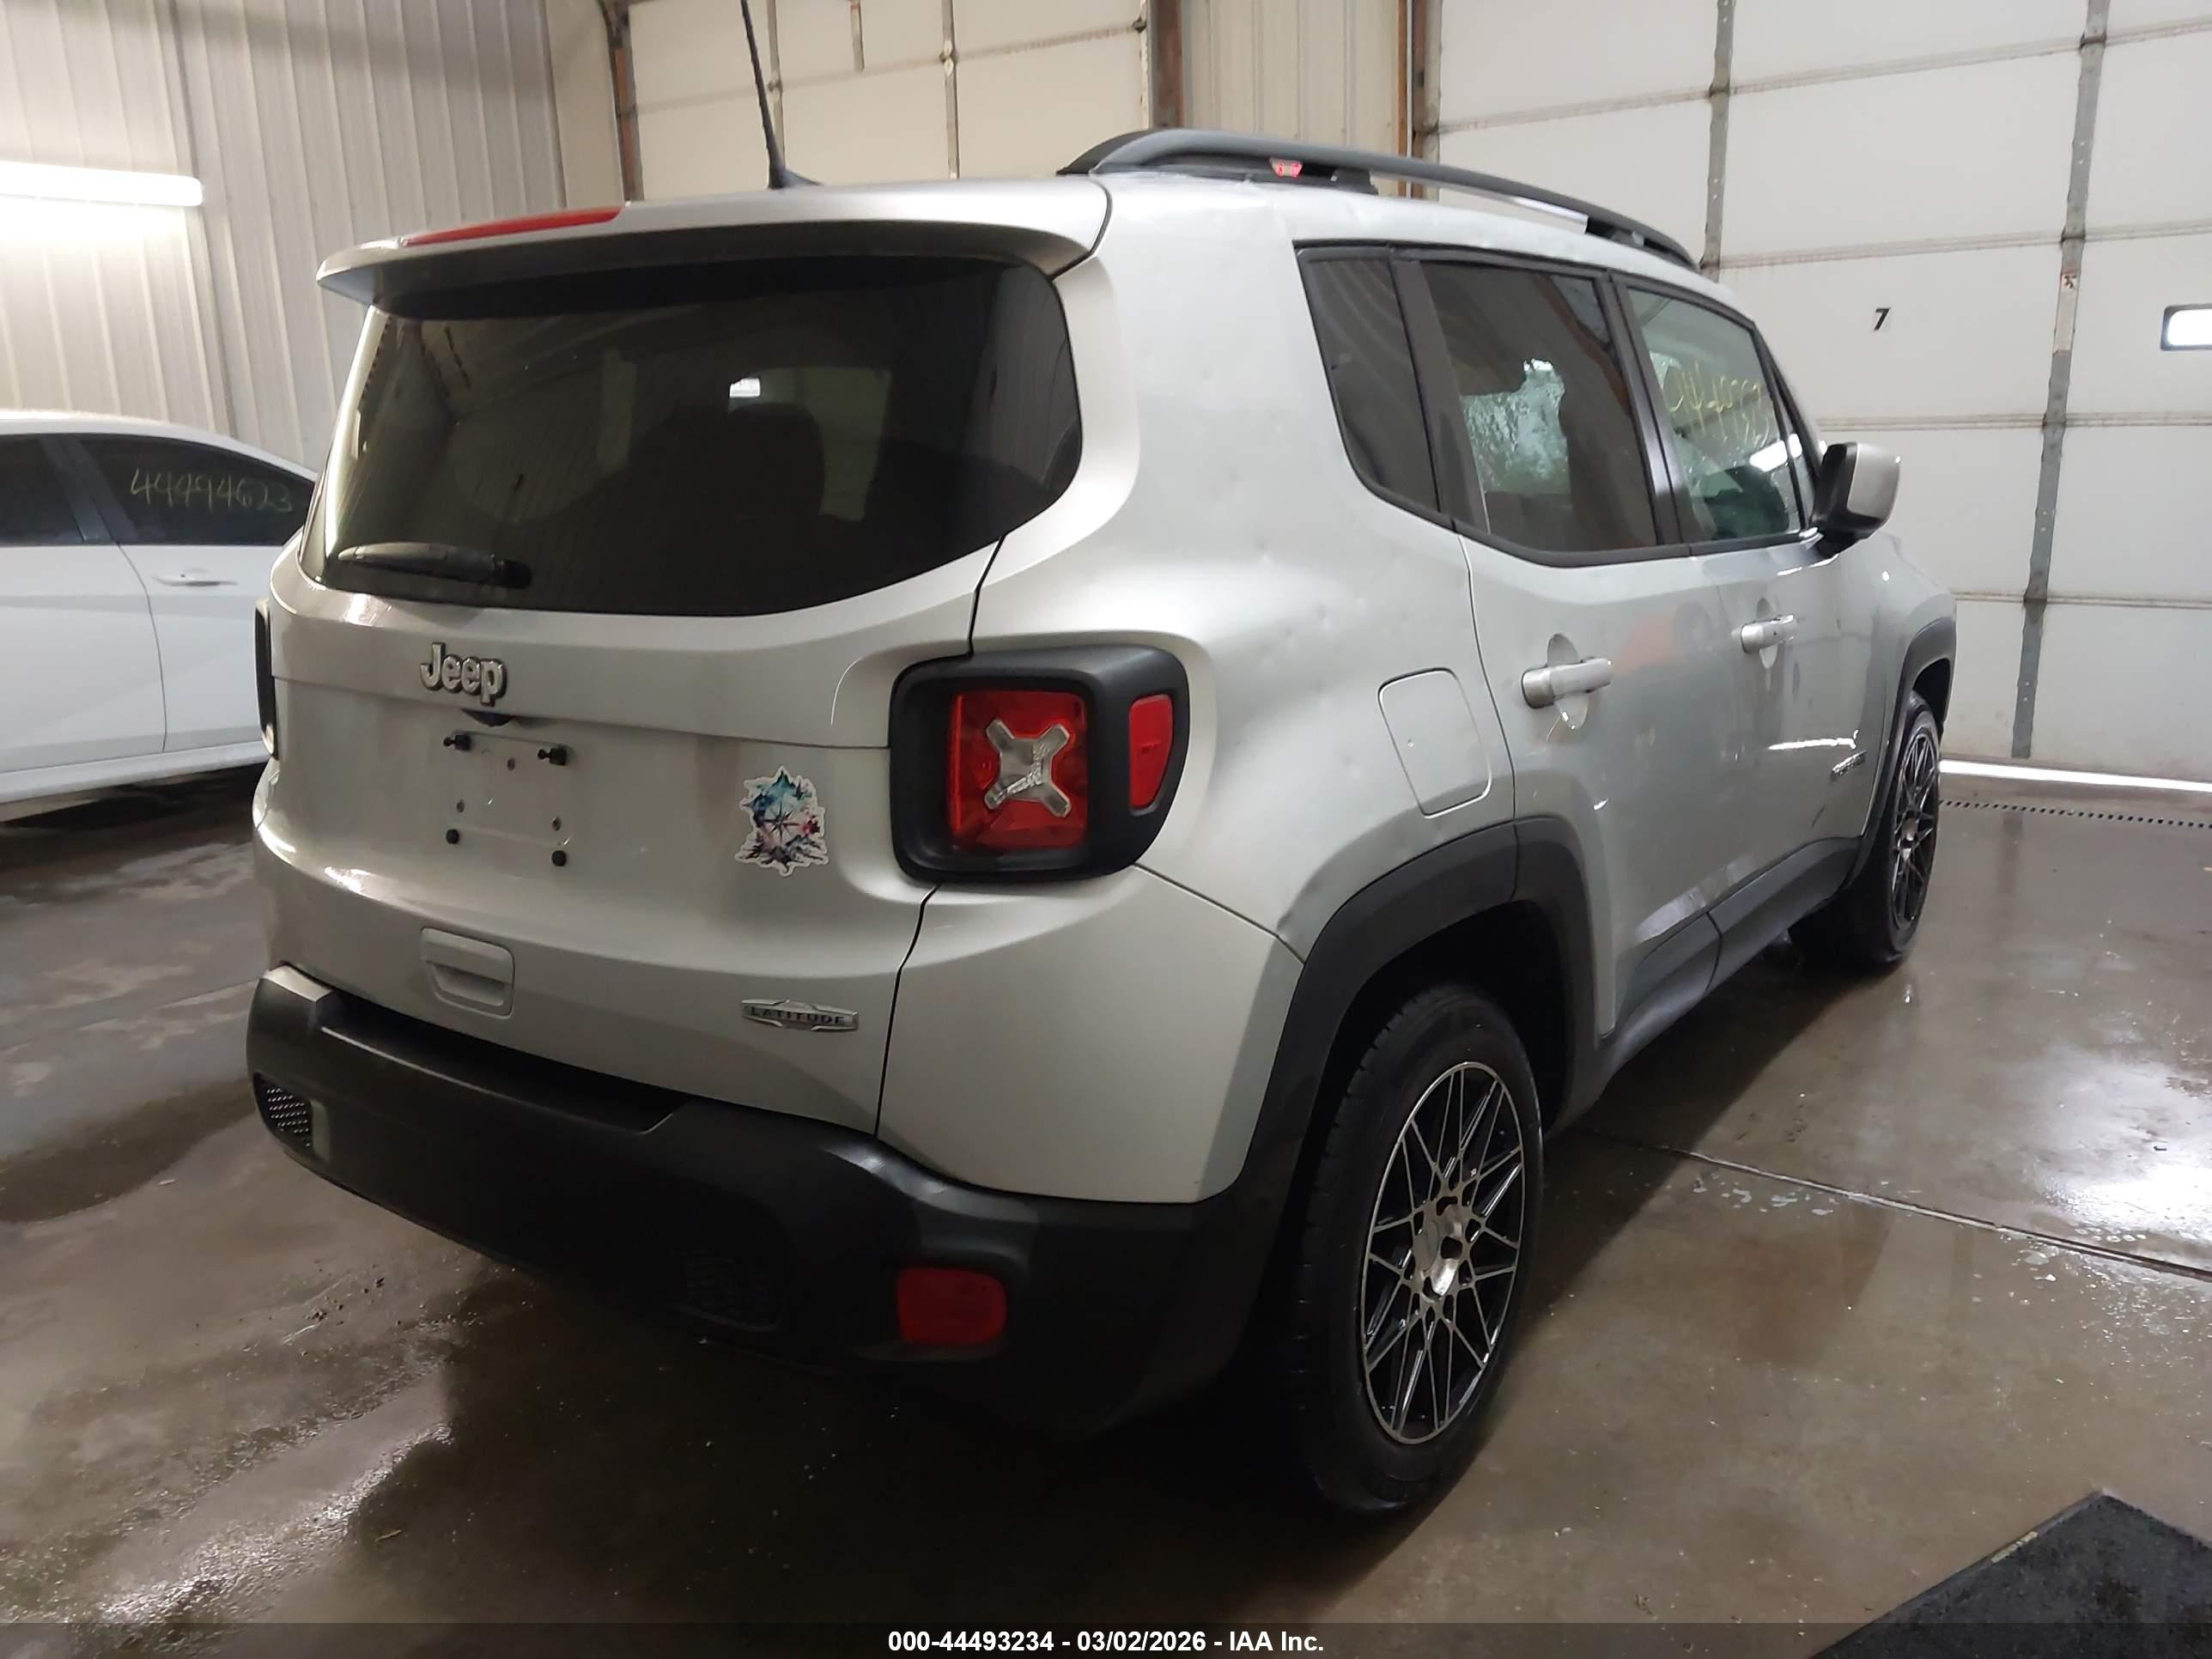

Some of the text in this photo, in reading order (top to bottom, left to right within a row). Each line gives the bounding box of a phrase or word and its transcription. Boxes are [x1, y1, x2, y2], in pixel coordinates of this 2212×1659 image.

[1875, 307, 1891, 331] 7
[420, 642, 507, 708] Jeep
[750, 1006, 845, 1024] LATITUDE
